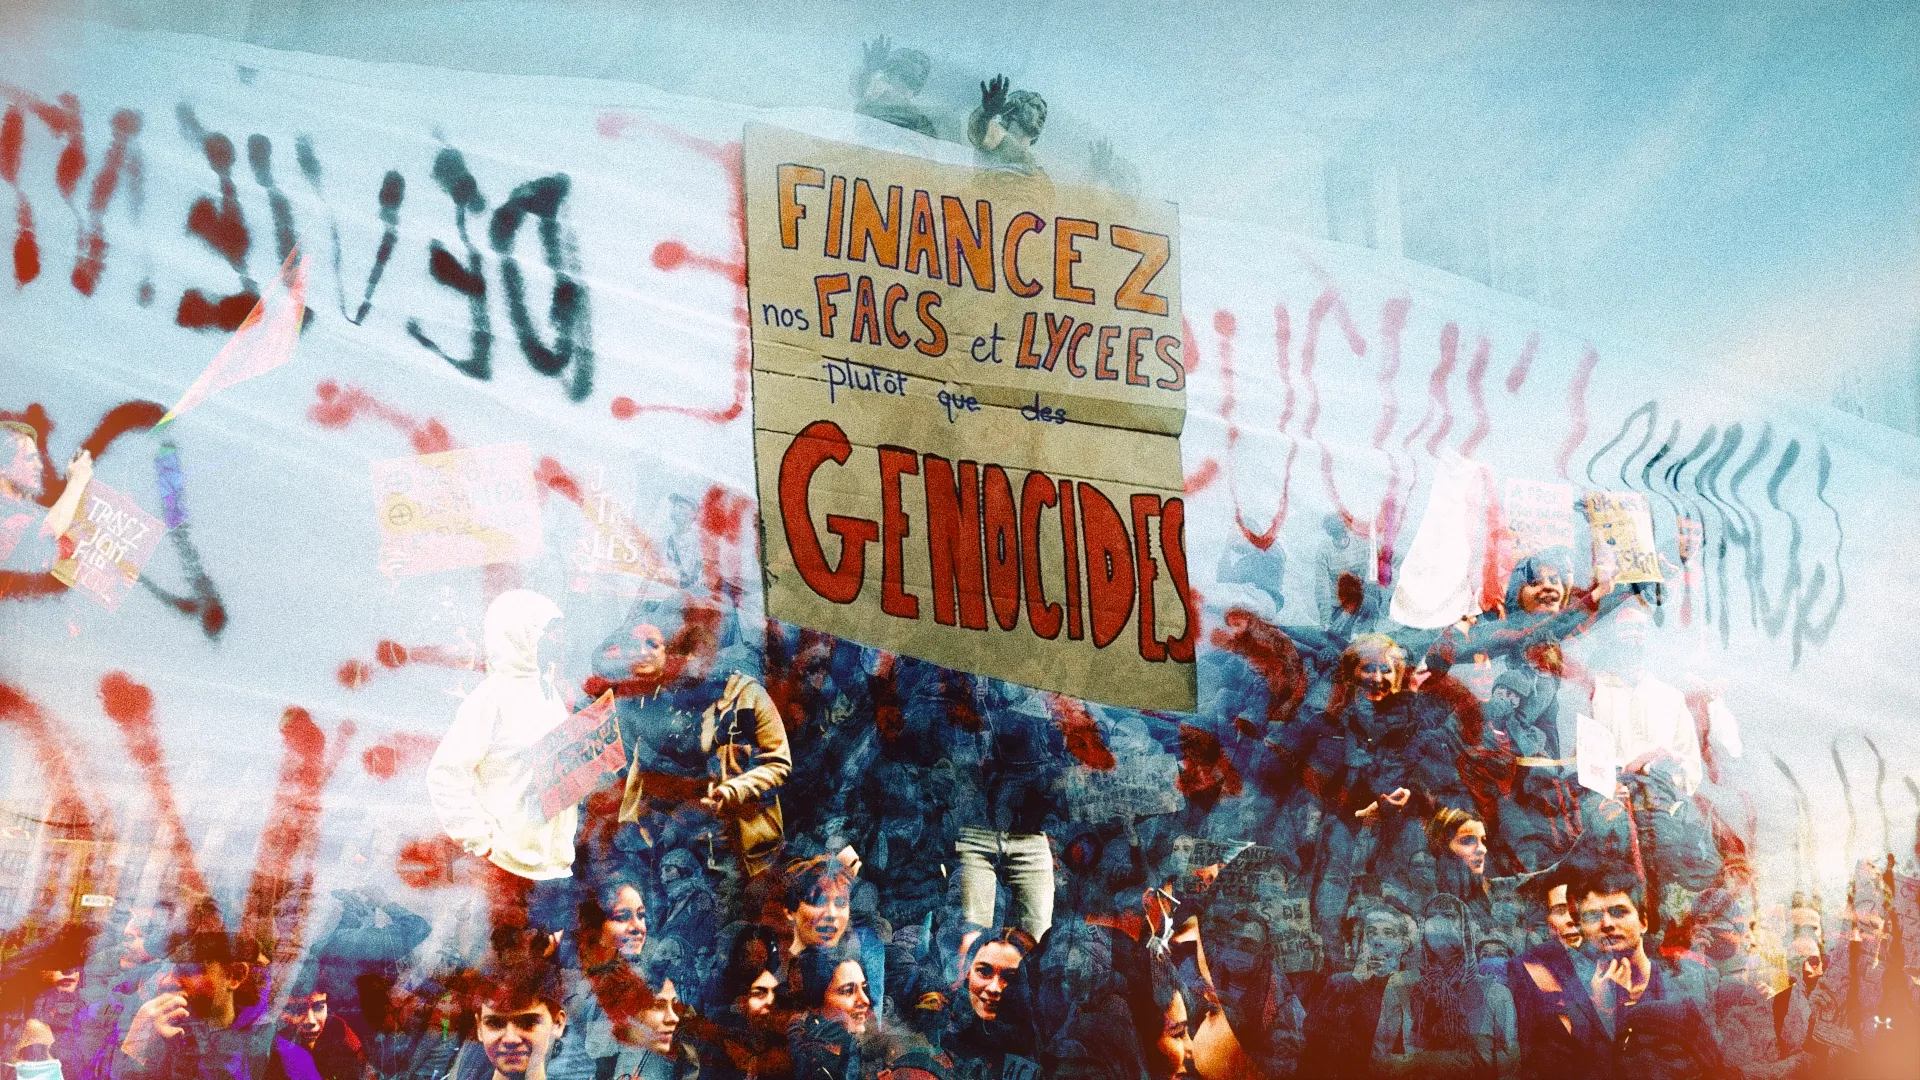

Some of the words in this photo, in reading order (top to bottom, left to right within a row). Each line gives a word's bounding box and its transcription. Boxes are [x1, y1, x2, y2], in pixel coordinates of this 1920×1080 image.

[776, 162, 1171, 317] FINANCEZ
[762, 303, 810, 331] nos
[814, 272, 949, 358] FACS
[970, 322, 1004, 364] et
[1015, 311, 1186, 391] LYCEES
[823, 356, 908, 403] plutôt
[937, 388, 981, 424] que
[1020, 393, 1067, 425] des
[777, 419, 1198, 663] GENOCIDES
